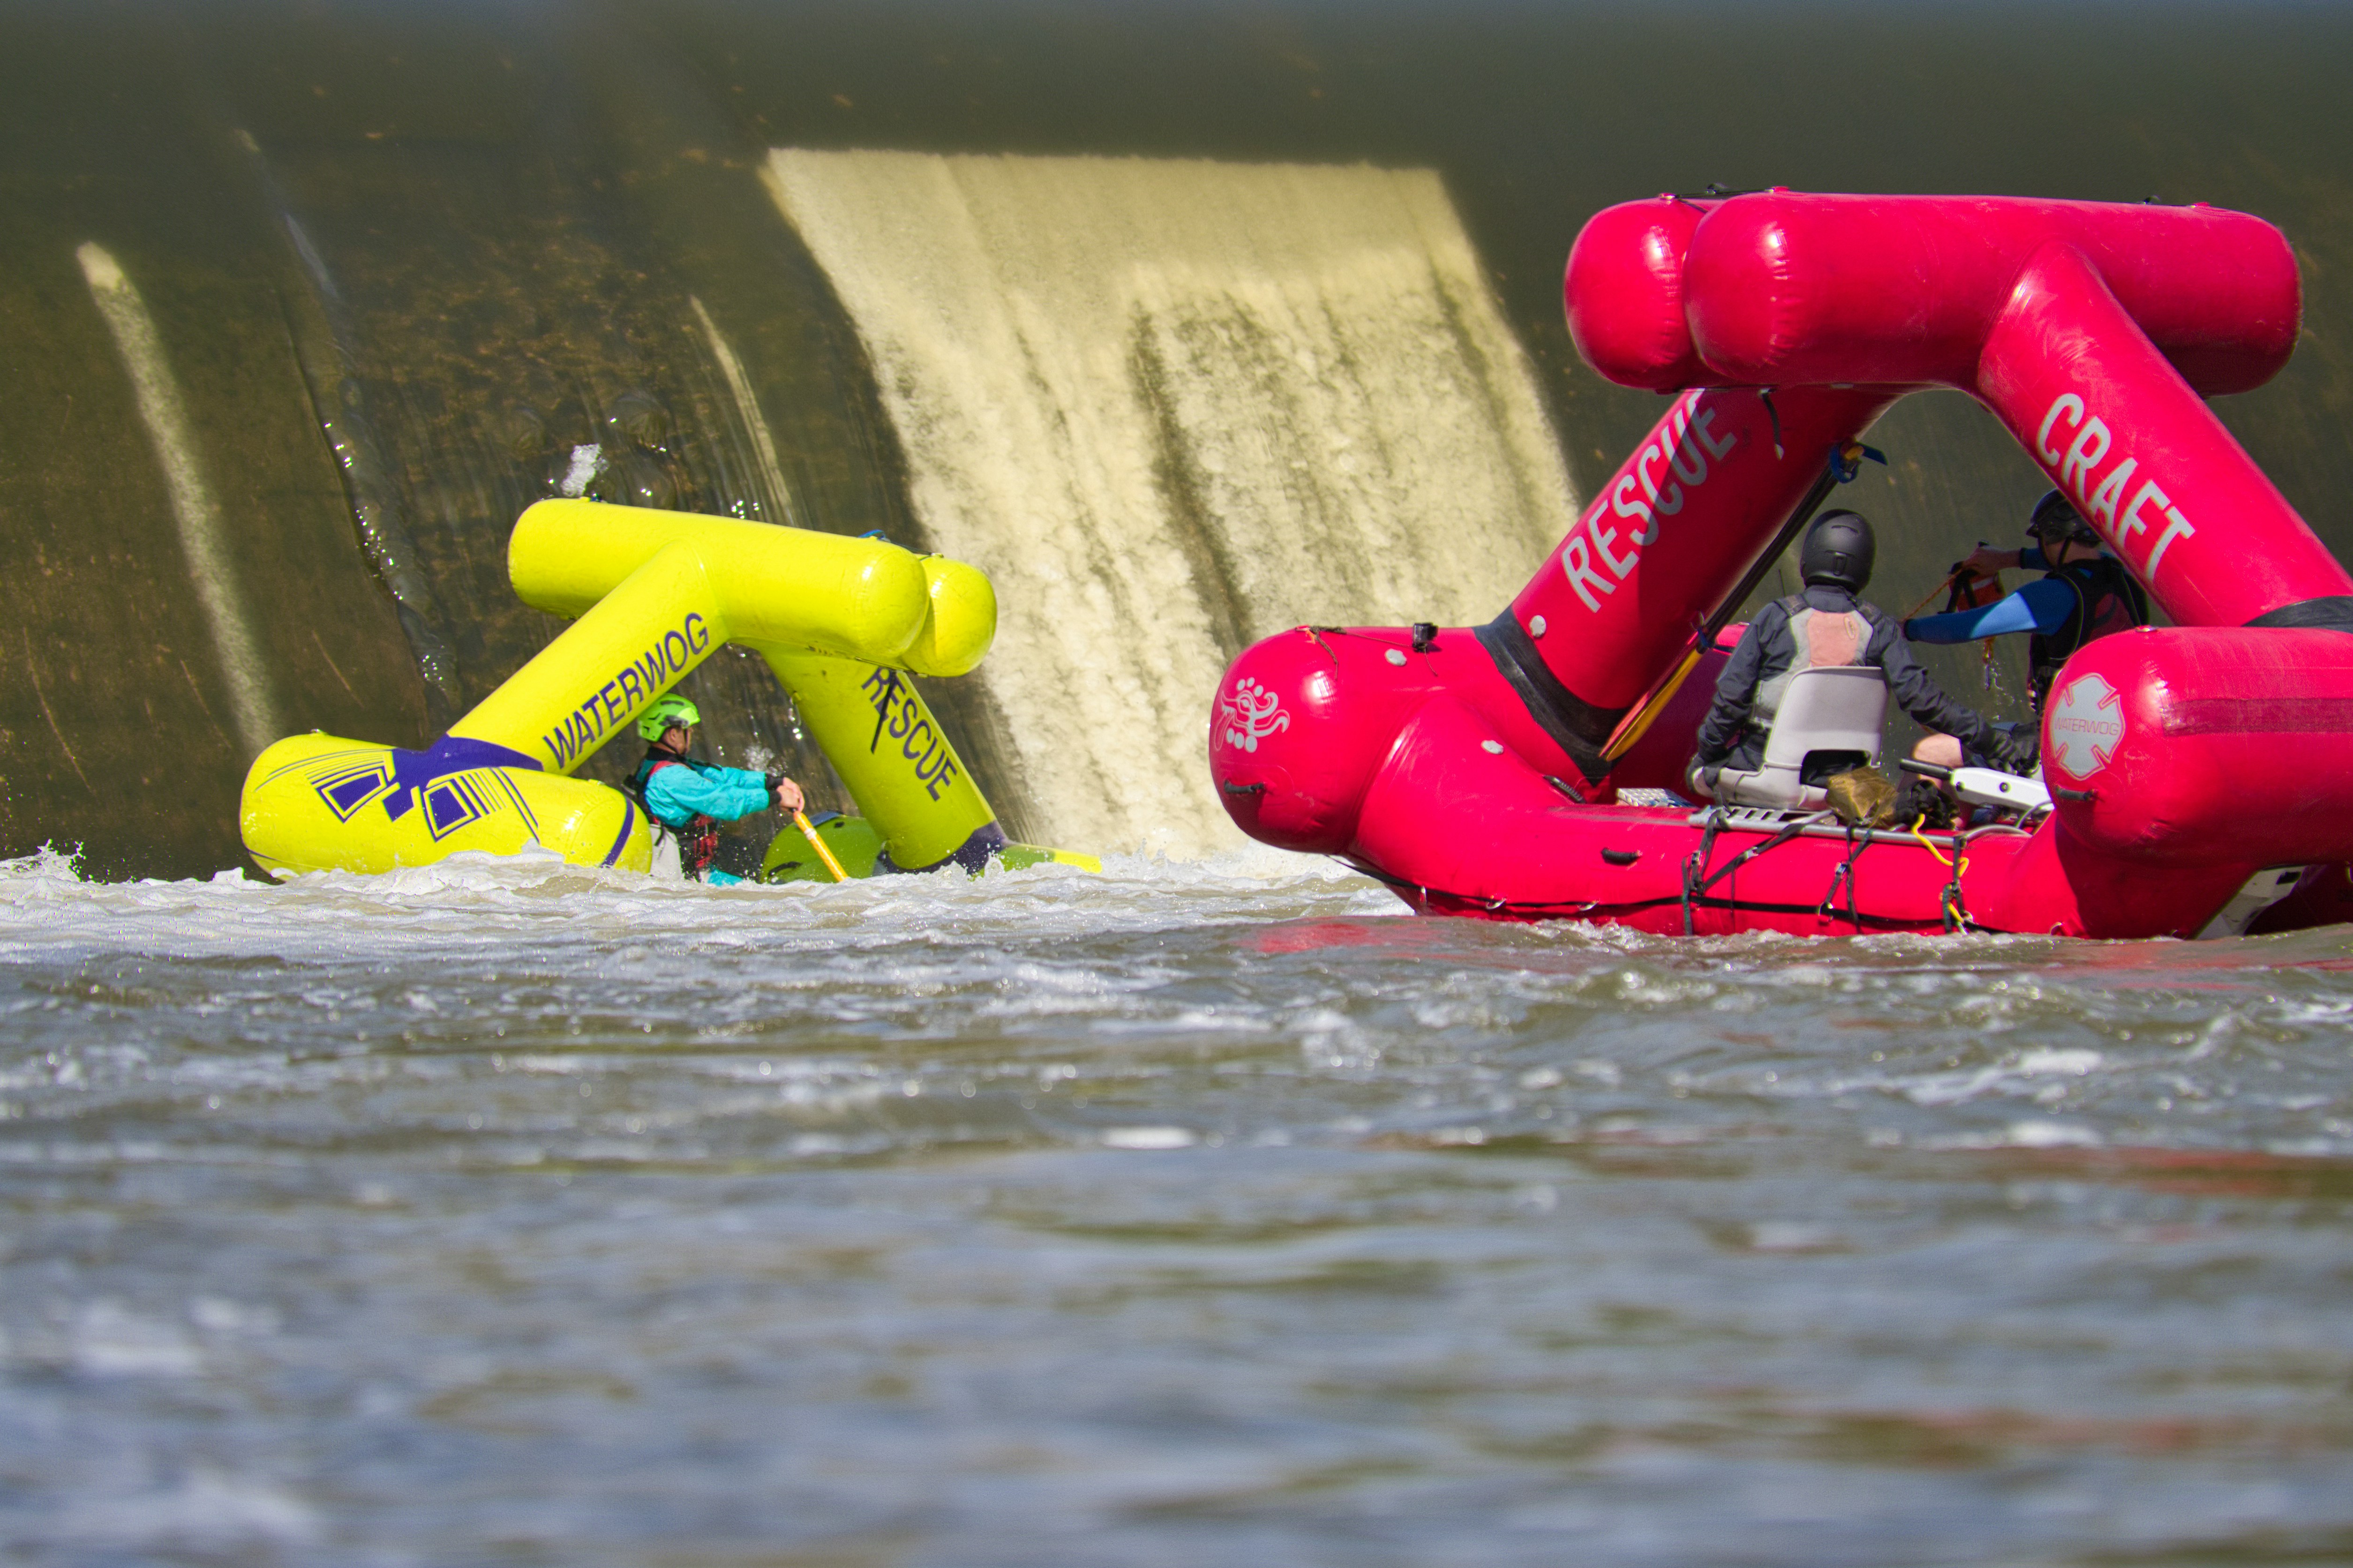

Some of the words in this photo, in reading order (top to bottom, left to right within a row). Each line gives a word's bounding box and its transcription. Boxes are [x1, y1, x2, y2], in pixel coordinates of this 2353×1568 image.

[1562, 388, 1737, 614] RESCUE
[2036, 393, 2196, 580] CRAFT
[542, 612, 709, 769] WATERWOG
[861, 666, 957, 802] RESCUE
[2054, 717, 2120, 735] WATERWOG
